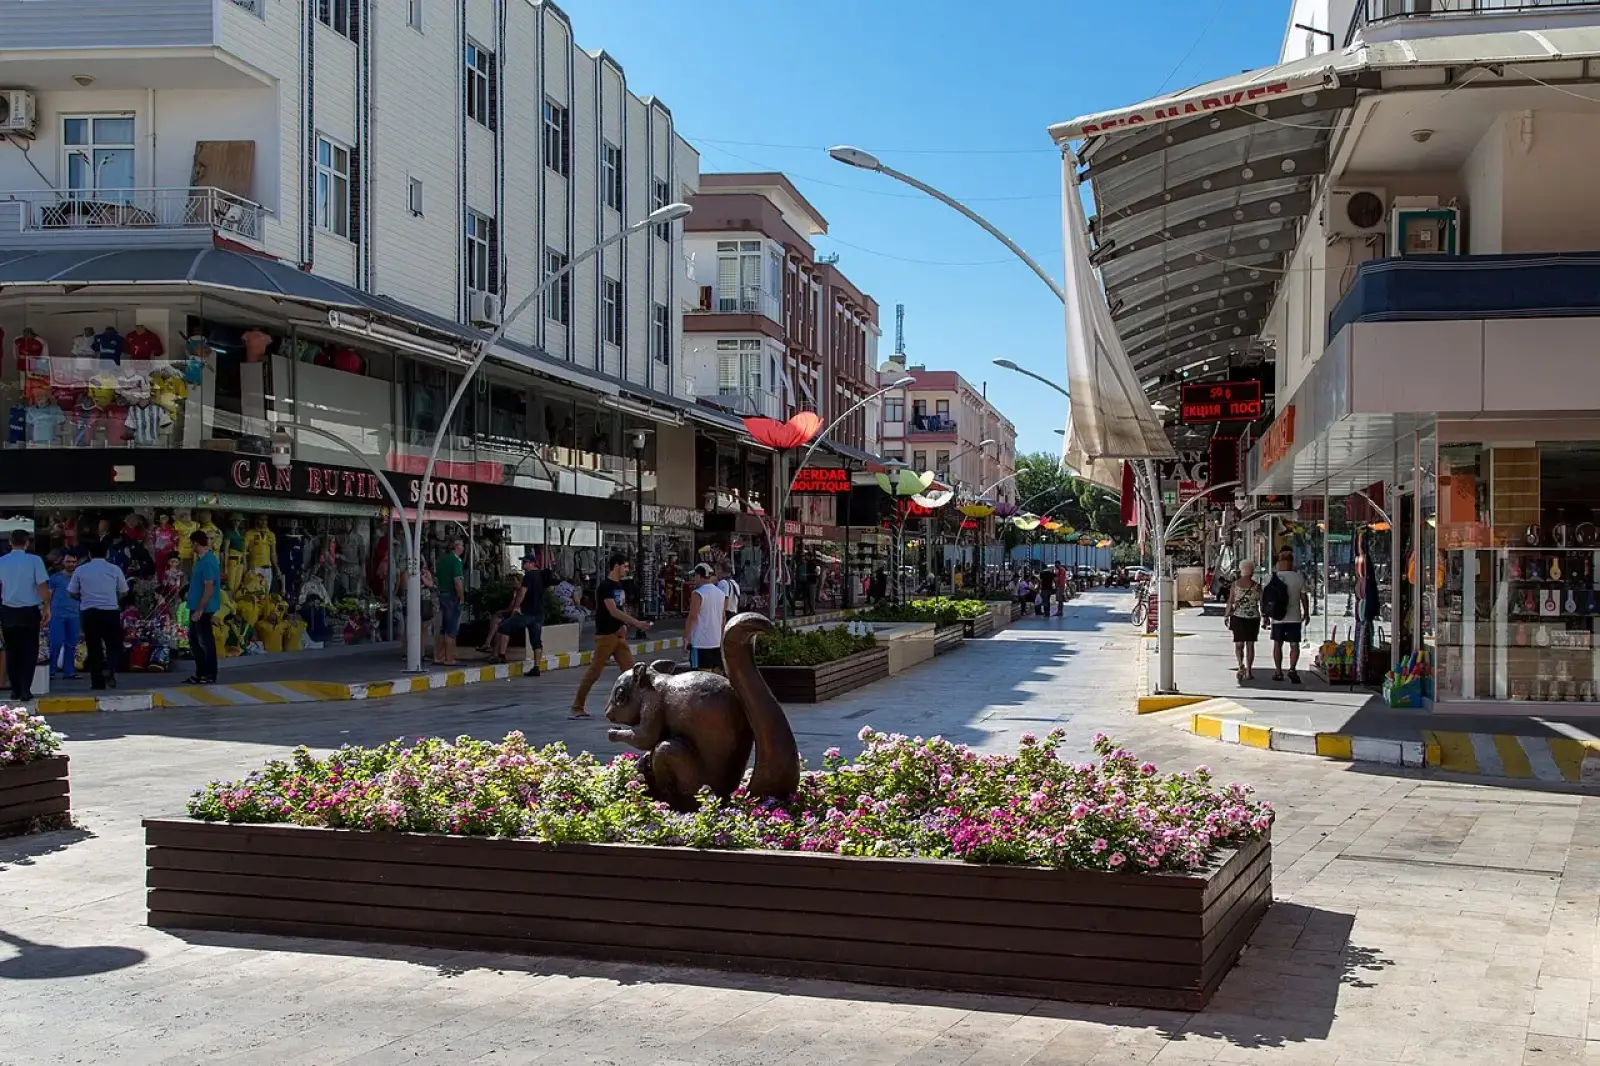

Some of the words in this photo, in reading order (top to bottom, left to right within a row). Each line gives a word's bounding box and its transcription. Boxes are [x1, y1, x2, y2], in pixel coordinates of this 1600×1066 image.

[794, 469, 847, 480] SERDAR
[232, 459, 293, 492] CAN
[307, 467, 384, 500] BUTIK
[409, 479, 469, 507] SHOES
[38, 494, 73, 506] GOLF
[104, 493, 149, 504] TENNIS
[159, 492, 195, 504] SHOP
